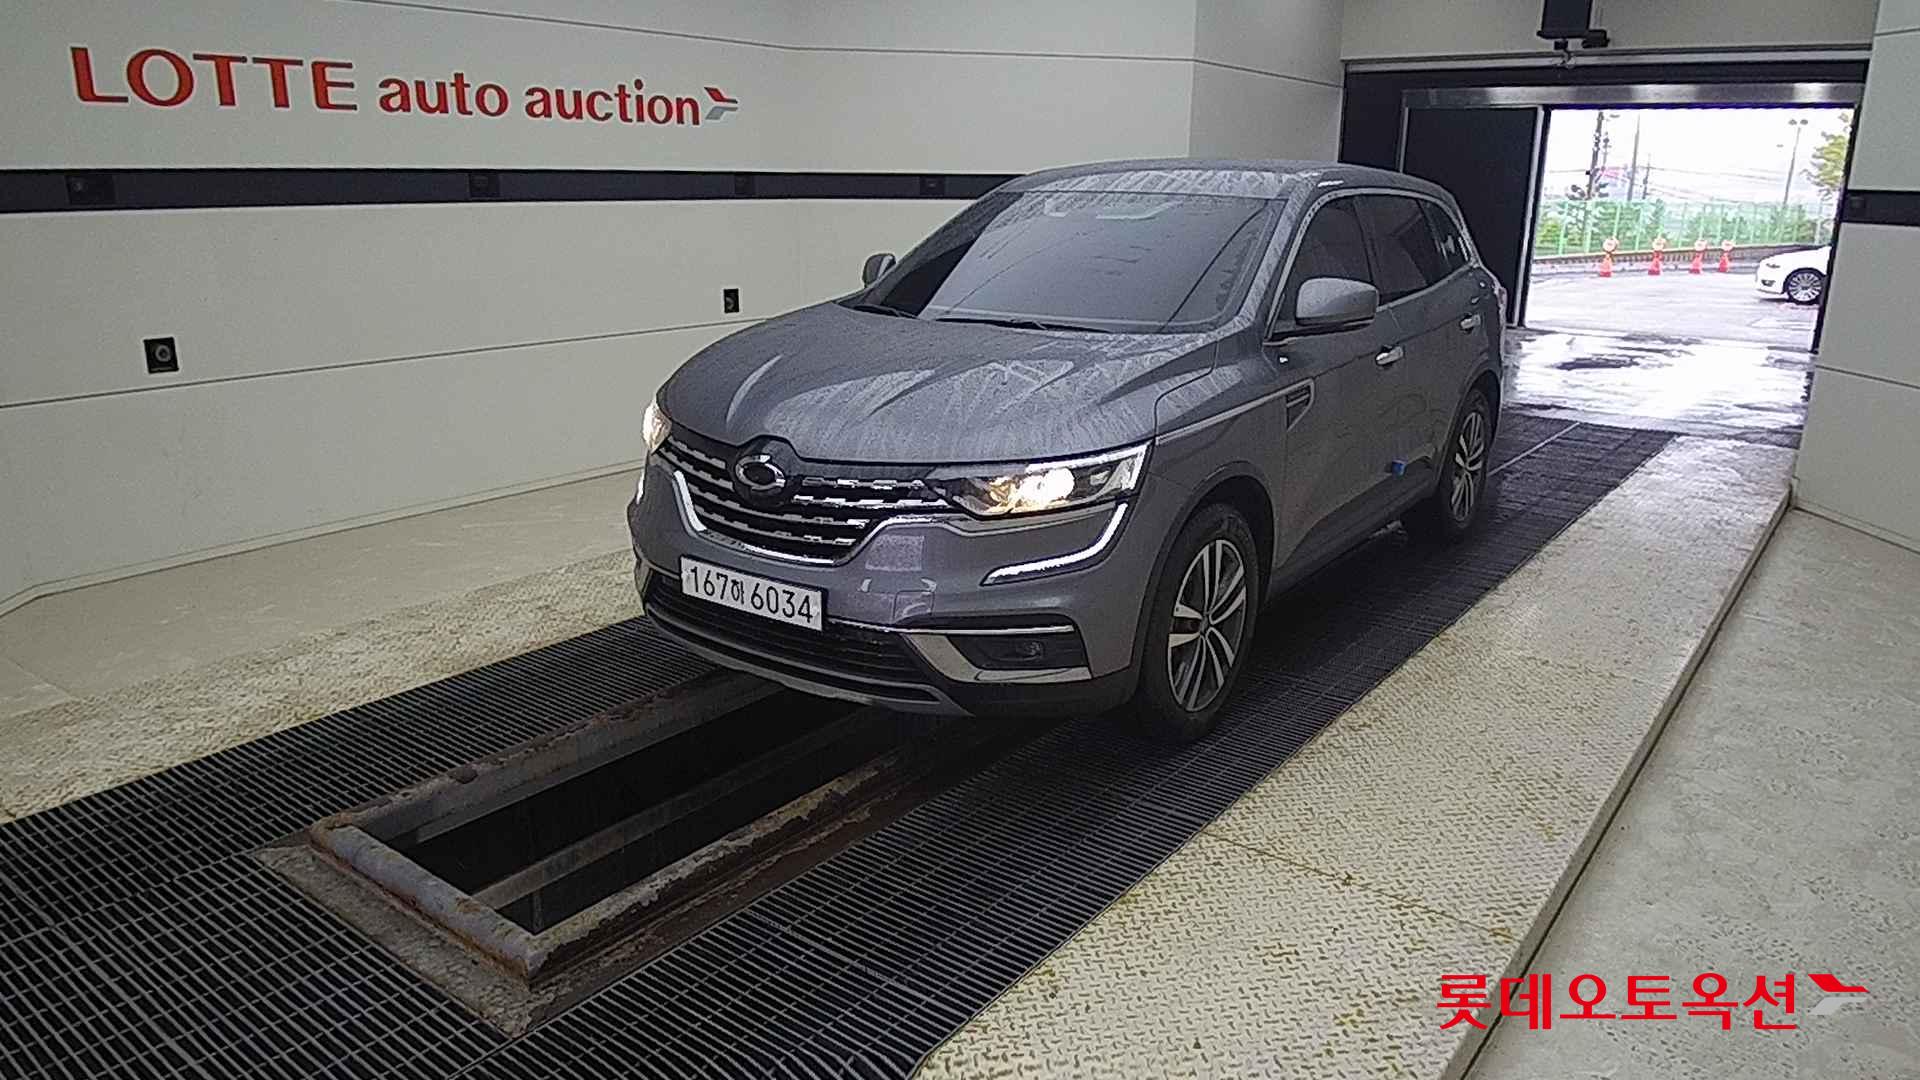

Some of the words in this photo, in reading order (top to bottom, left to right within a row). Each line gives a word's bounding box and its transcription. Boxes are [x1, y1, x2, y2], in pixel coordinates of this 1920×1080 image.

[70, 46, 356, 112] LOTTE
[378, 72, 509, 117] auto
[525, 79, 700, 125] auction
